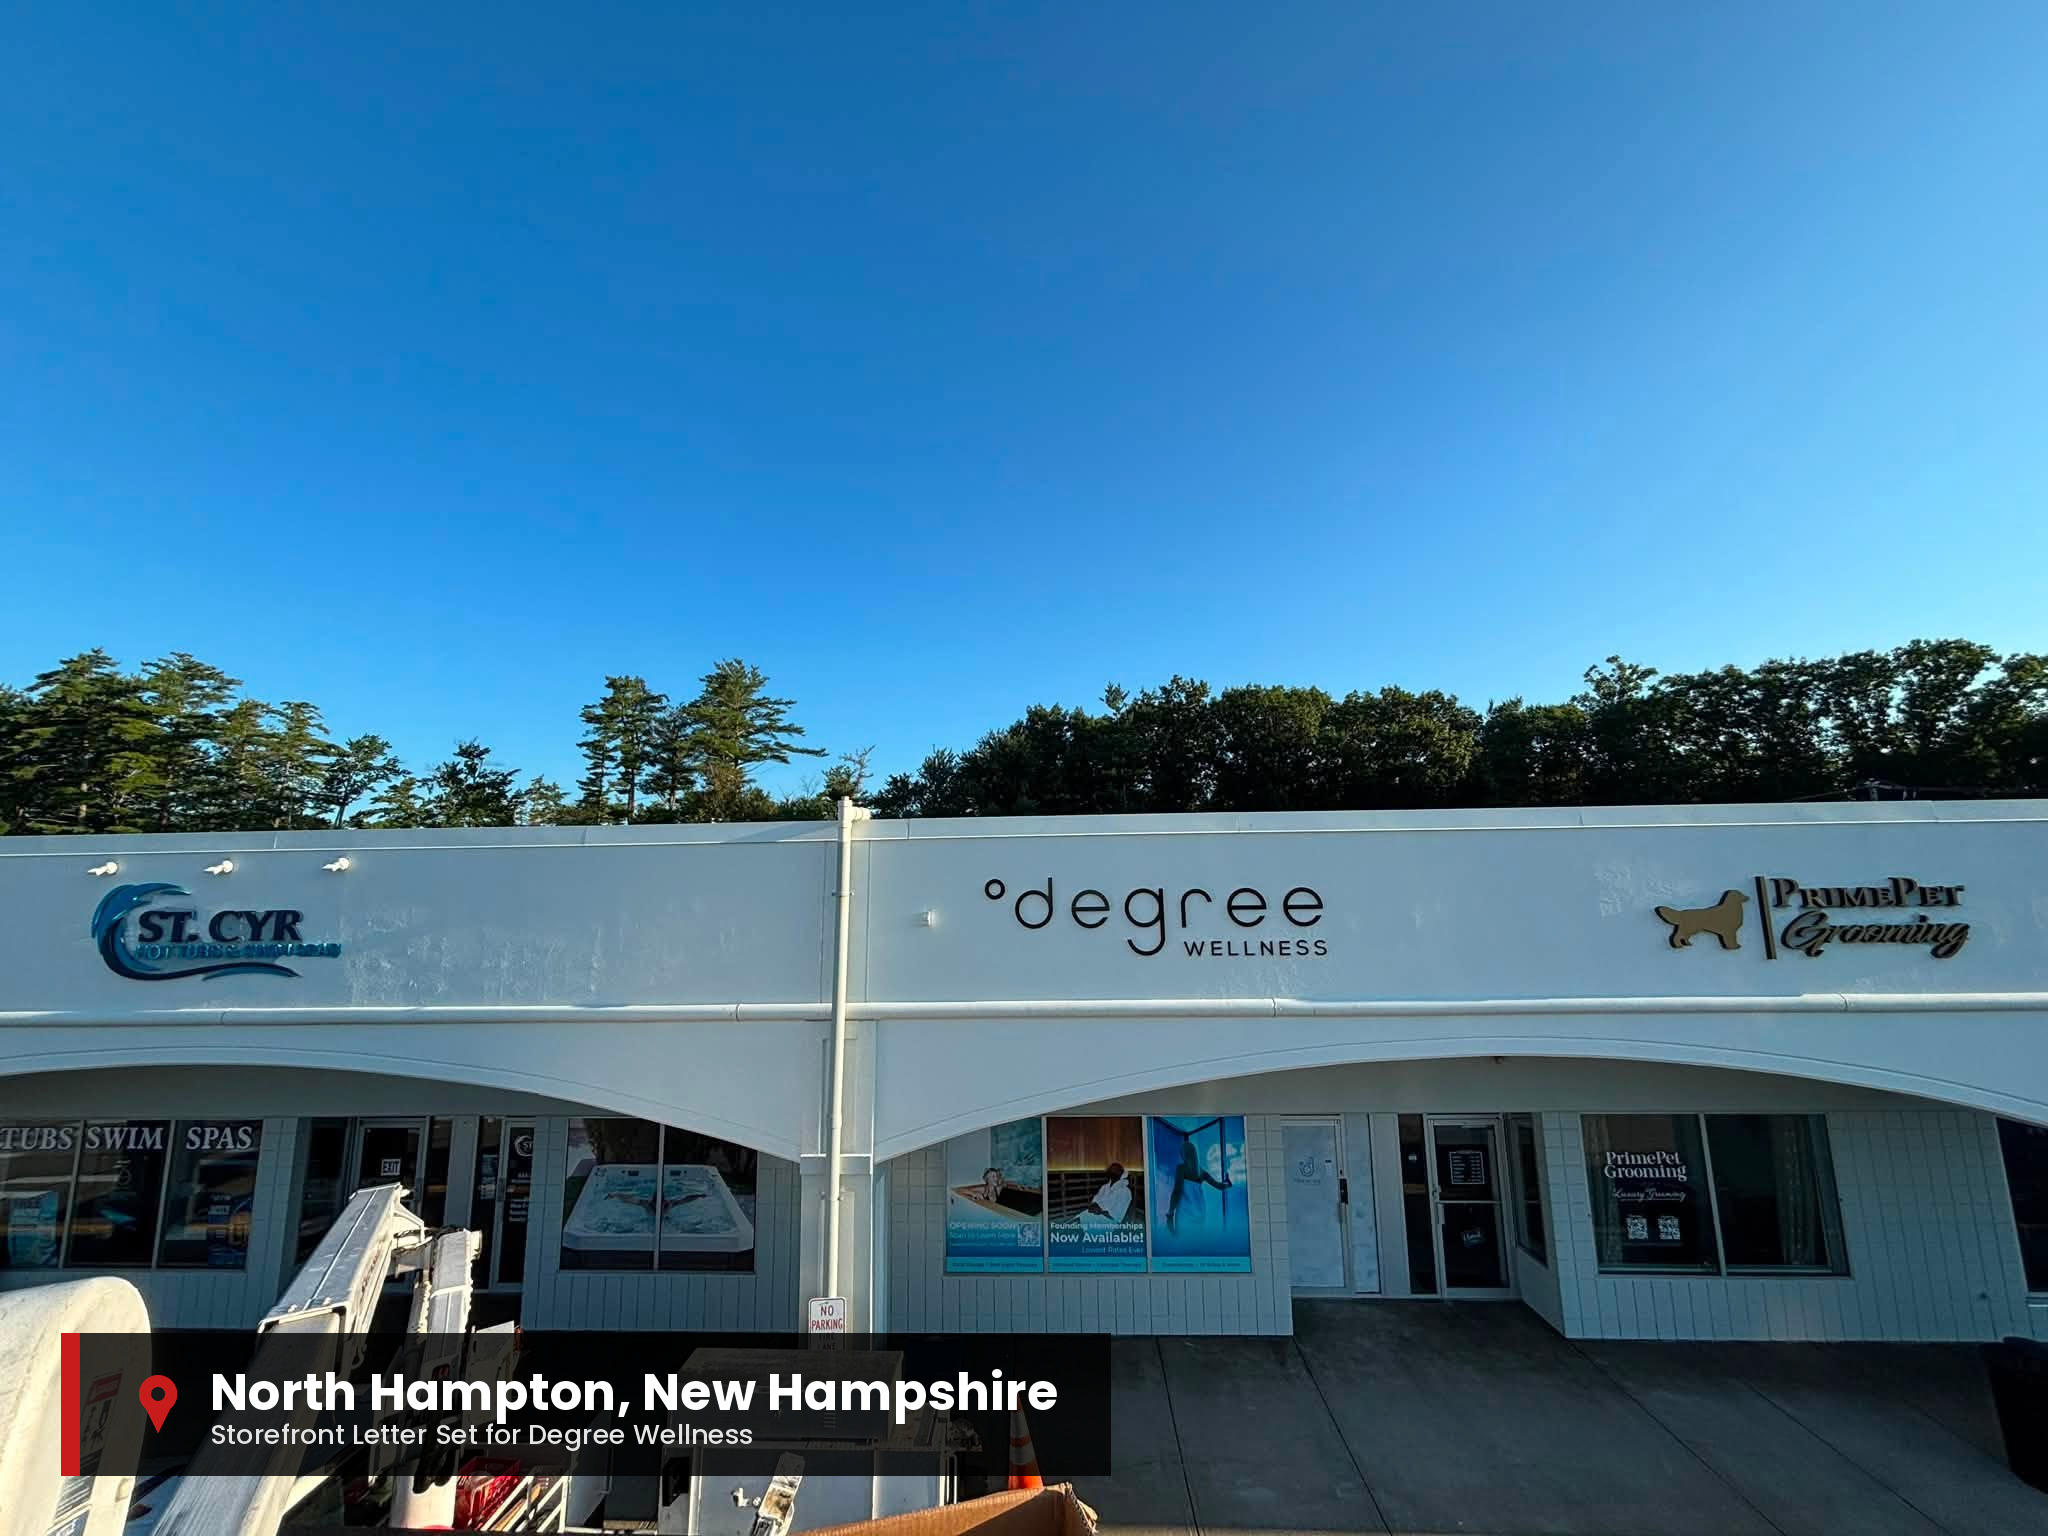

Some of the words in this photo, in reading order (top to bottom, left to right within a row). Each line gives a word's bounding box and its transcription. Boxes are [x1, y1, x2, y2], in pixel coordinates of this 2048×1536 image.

[138, 910, 200, 943] ST.
[208, 909, 304, 942] CYR
[1780, 910, 1971, 959] Grooming
[1184, 940, 1328, 956] WELLNESS
[85, 1126, 164, 1150] SWIM
[185, 1125, 254, 1150] SPAS
[1606, 1151, 1682, 1165] PrimePet
[383, 1160, 400, 1174] EXIT
[1604, 1164, 1687, 1182] Grooming
[1050, 1222, 1087, 1231] Founding
[1089, 1222, 1143, 1231] Memberships
[1050, 1232, 1079, 1243] Now
[1082, 1231, 1144, 1243] Available!
[820, 1305, 834, 1317] NO
[811, 1318, 843, 1331] PARKING
